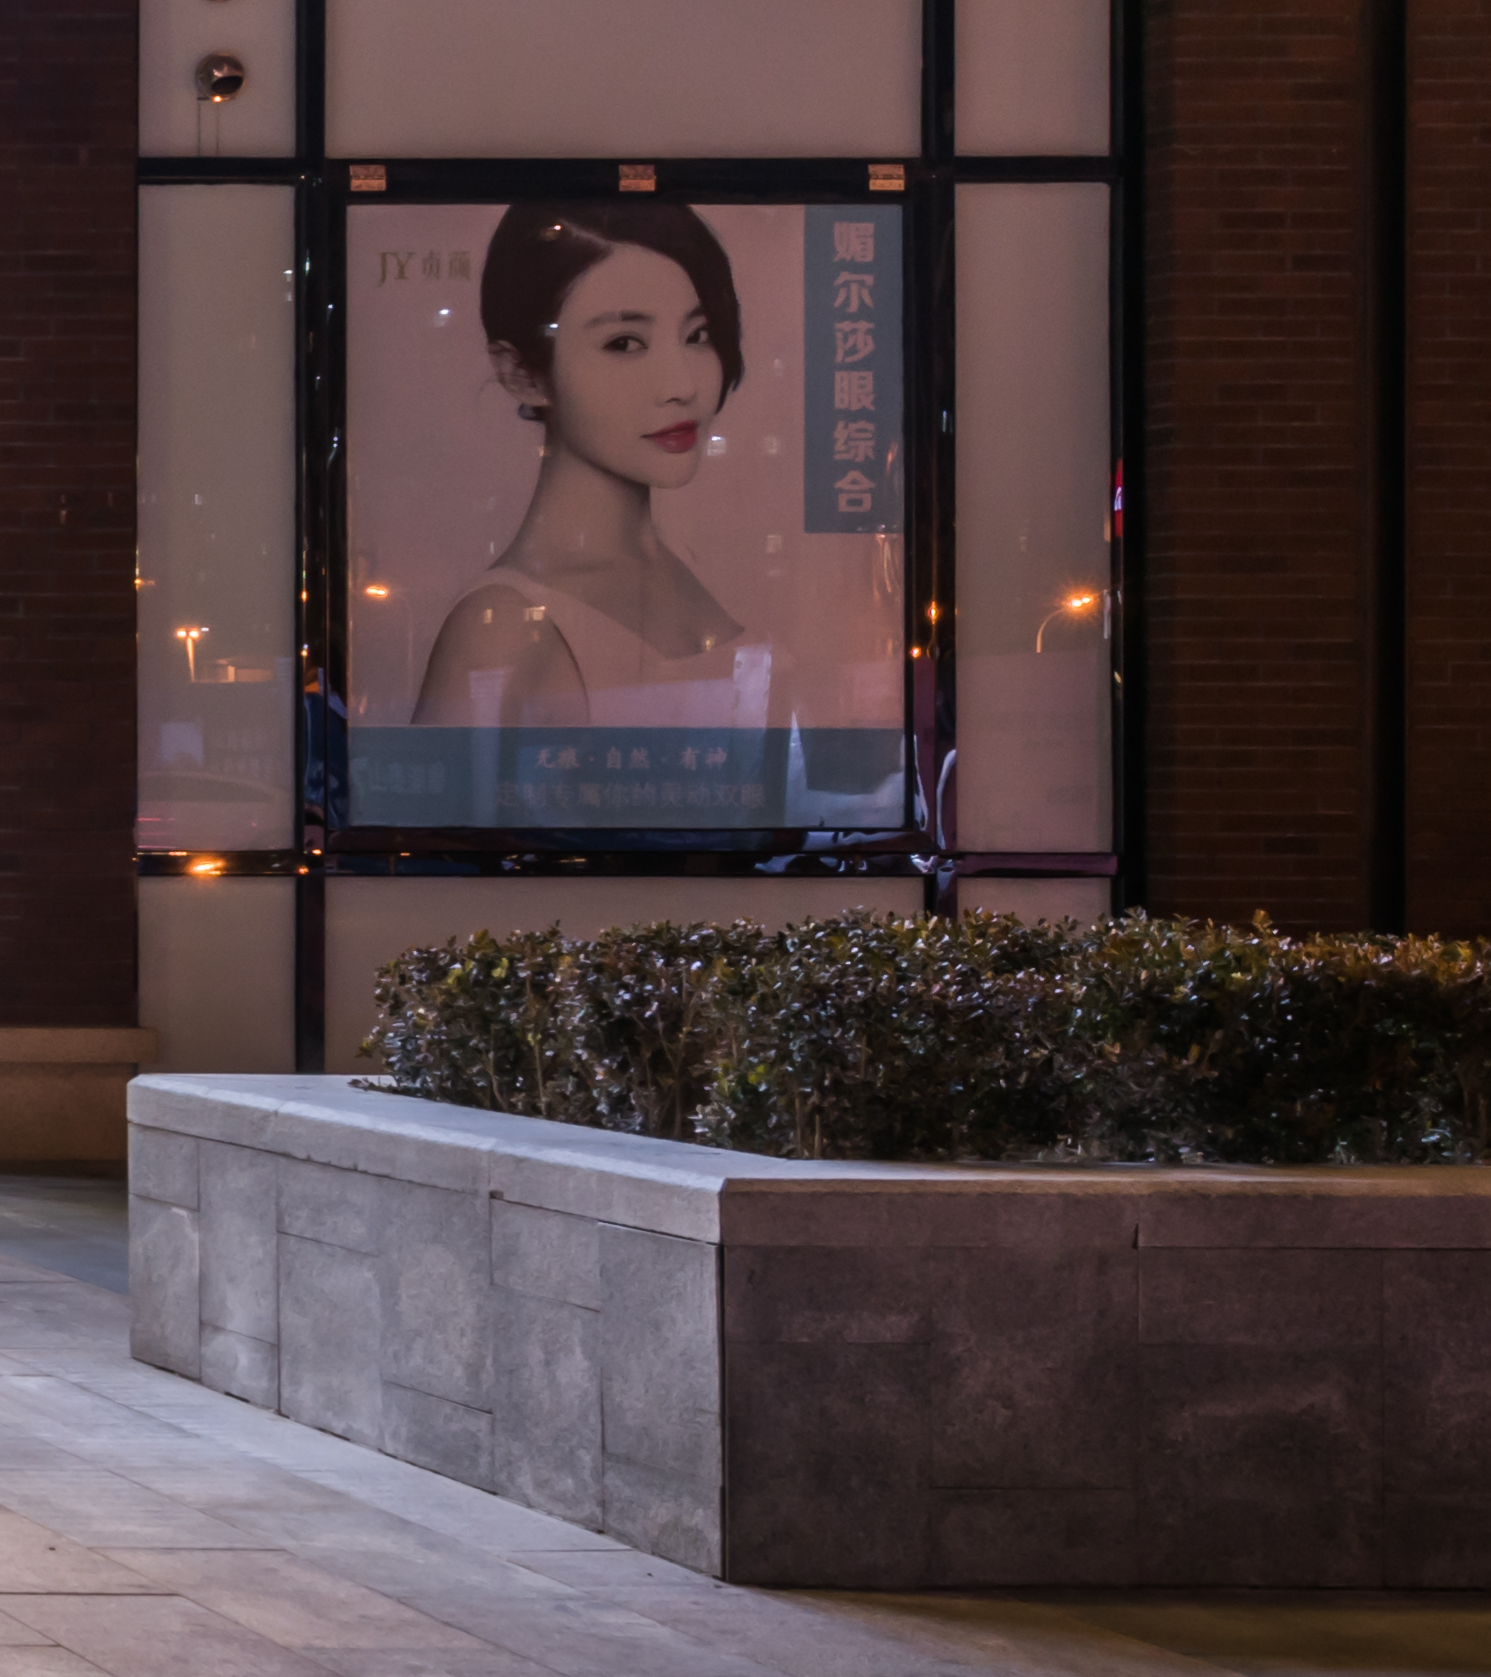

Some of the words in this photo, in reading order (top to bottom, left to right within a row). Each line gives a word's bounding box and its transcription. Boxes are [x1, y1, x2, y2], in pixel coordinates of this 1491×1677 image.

[831, 220, 877, 514] 媚尔莎眼综合
